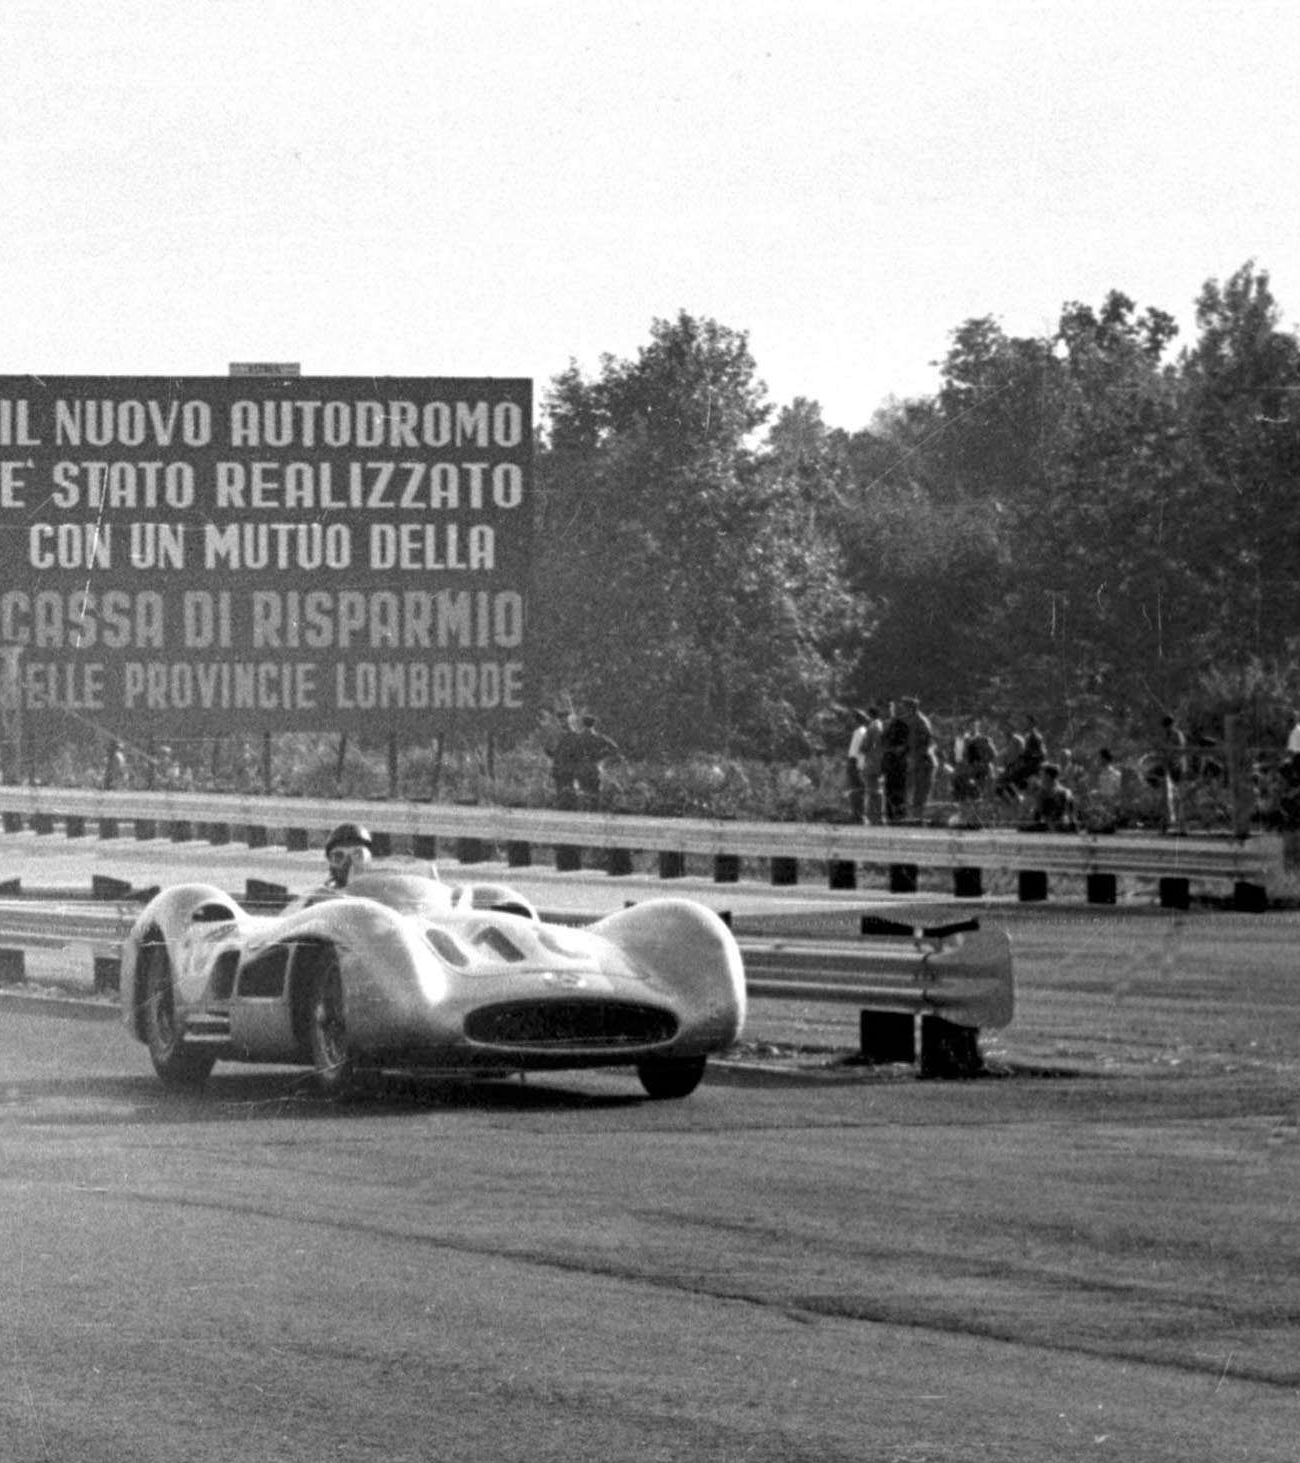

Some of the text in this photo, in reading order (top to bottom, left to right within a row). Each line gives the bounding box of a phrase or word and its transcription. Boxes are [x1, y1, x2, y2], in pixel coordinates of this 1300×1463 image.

[0, 400, 522, 447] IL NUOVO AUTODROMO
[53, 461, 195, 508] STATO
[217, 462, 523, 508] REALIZZATO
[30, 523, 495, 569] CON UN MUTUO DELLA
[0, 590, 524, 648] CASSA DI RISPARMIO
[3, 662, 523, 709] ELLE PROVINCIE LOMBARDE
